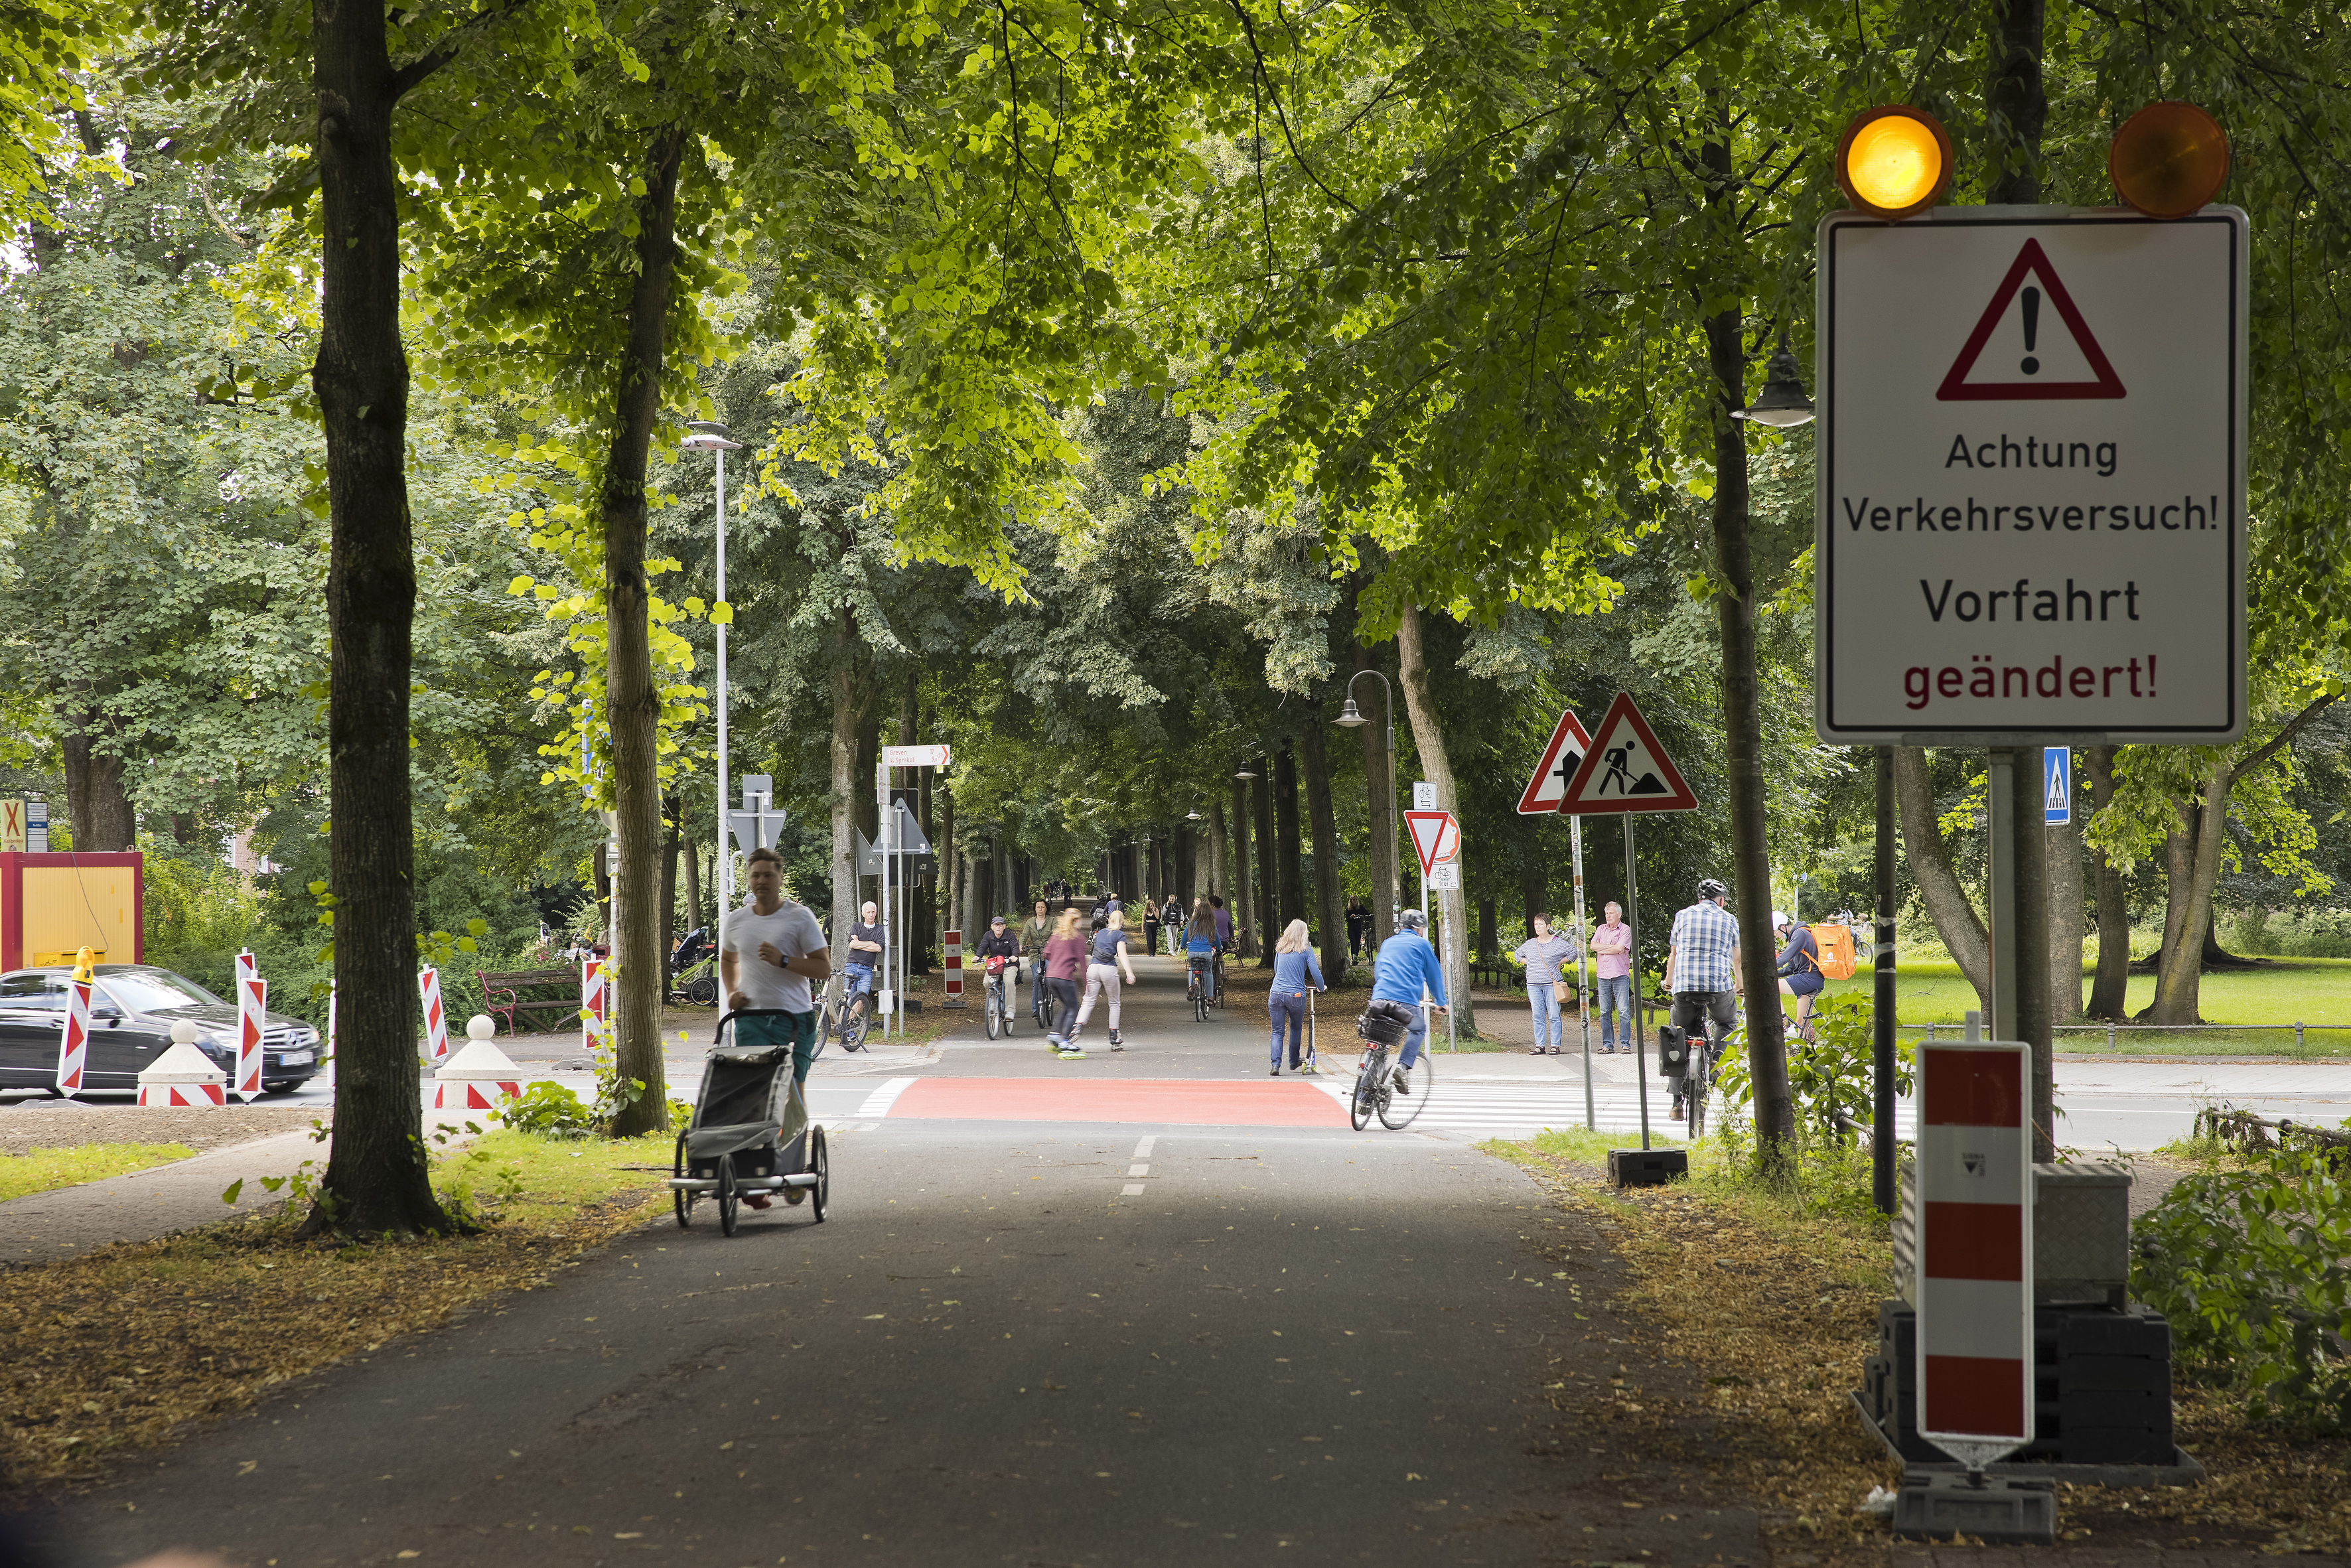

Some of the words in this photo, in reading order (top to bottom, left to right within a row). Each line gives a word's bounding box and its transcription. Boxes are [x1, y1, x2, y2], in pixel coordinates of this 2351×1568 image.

[1945, 434, 2117, 477] Achtung
[1843, 495, 2218, 532] Verkehrsversuch!
[1920, 578, 2139, 622] Vorfahrt
[1904, 654, 2157, 710] geändert!
